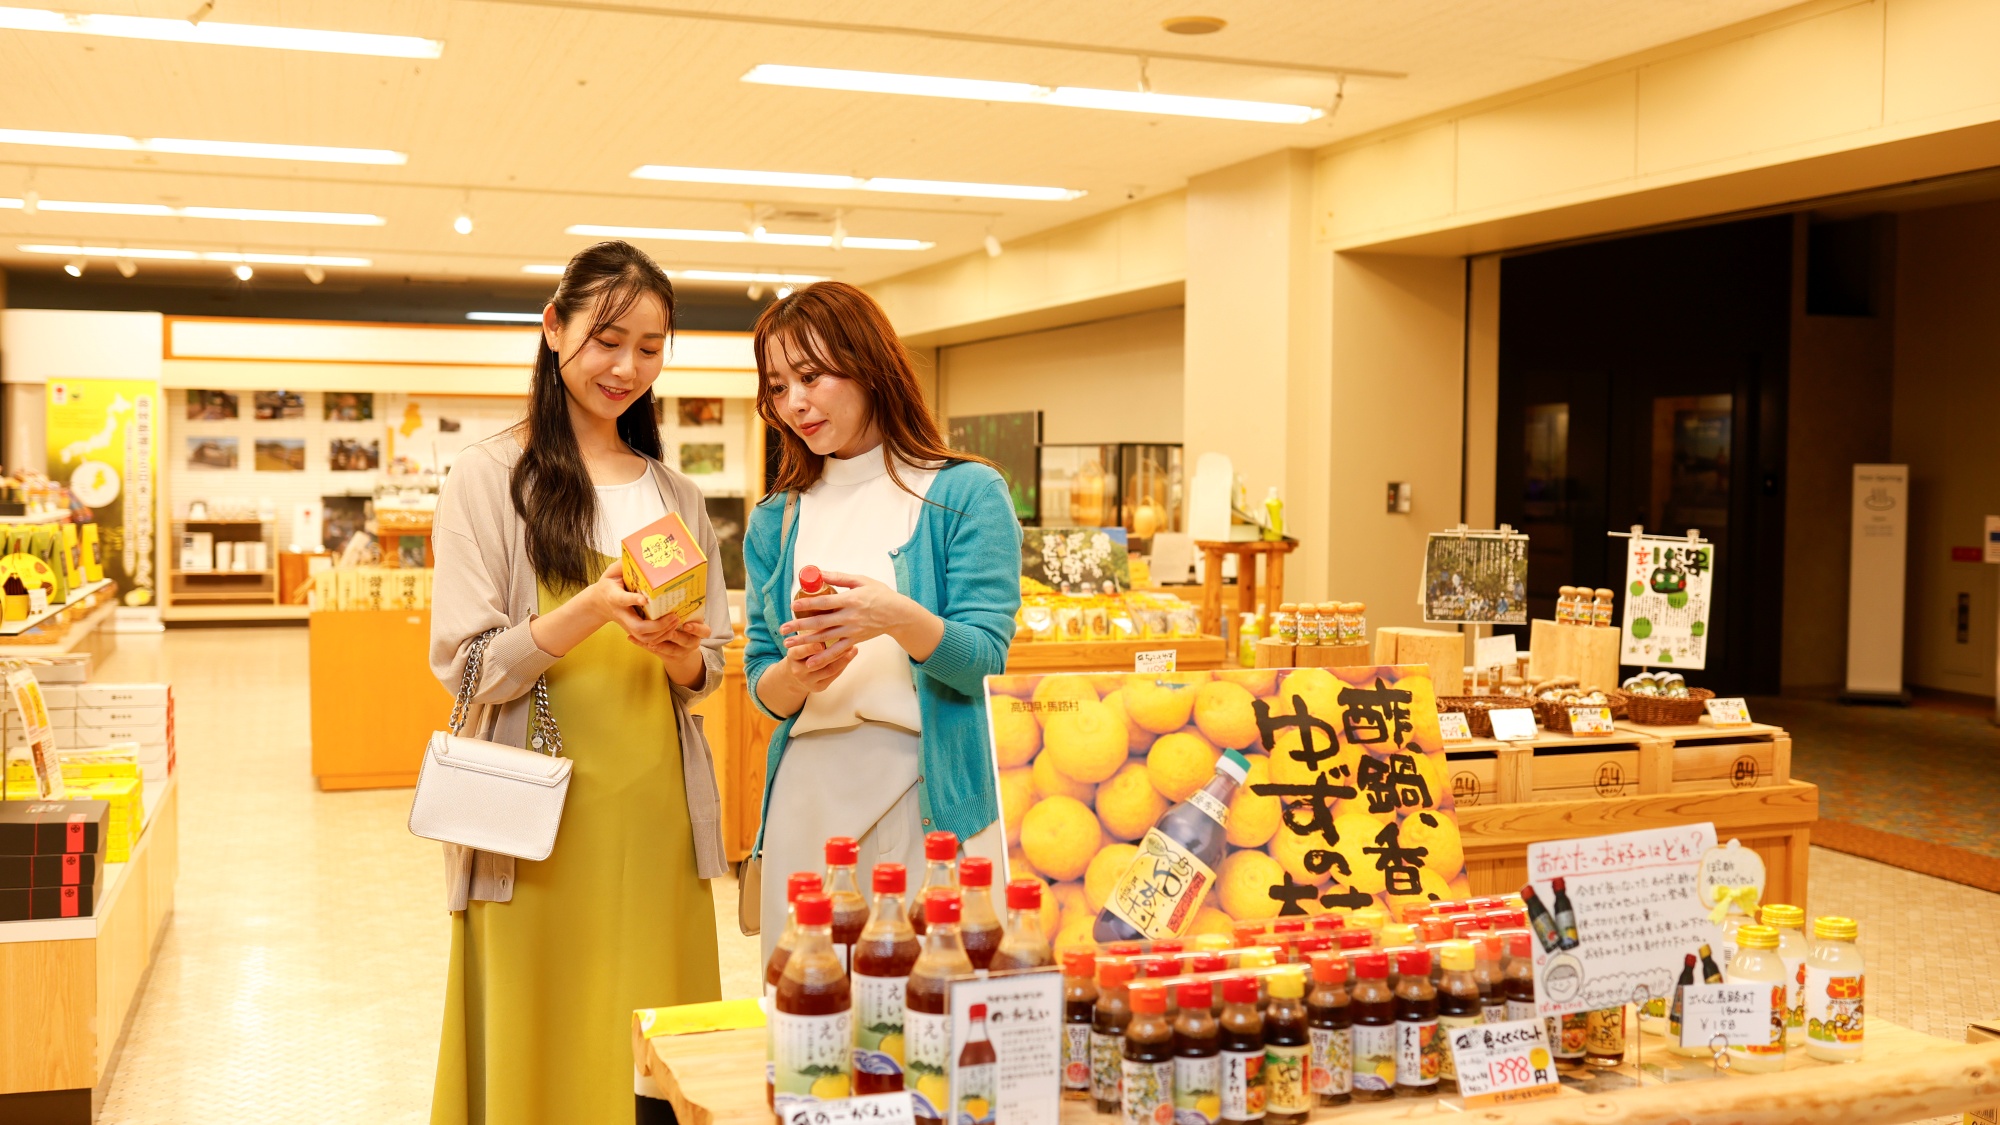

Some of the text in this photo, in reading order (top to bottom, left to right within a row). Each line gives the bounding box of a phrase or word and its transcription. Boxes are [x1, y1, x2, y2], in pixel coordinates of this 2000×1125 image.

[1010, 701, 1079, 713] 高知県・馬路村
[1600, 767, 1619, 786] 84
[1488, 1056, 1531, 1087] 1398
